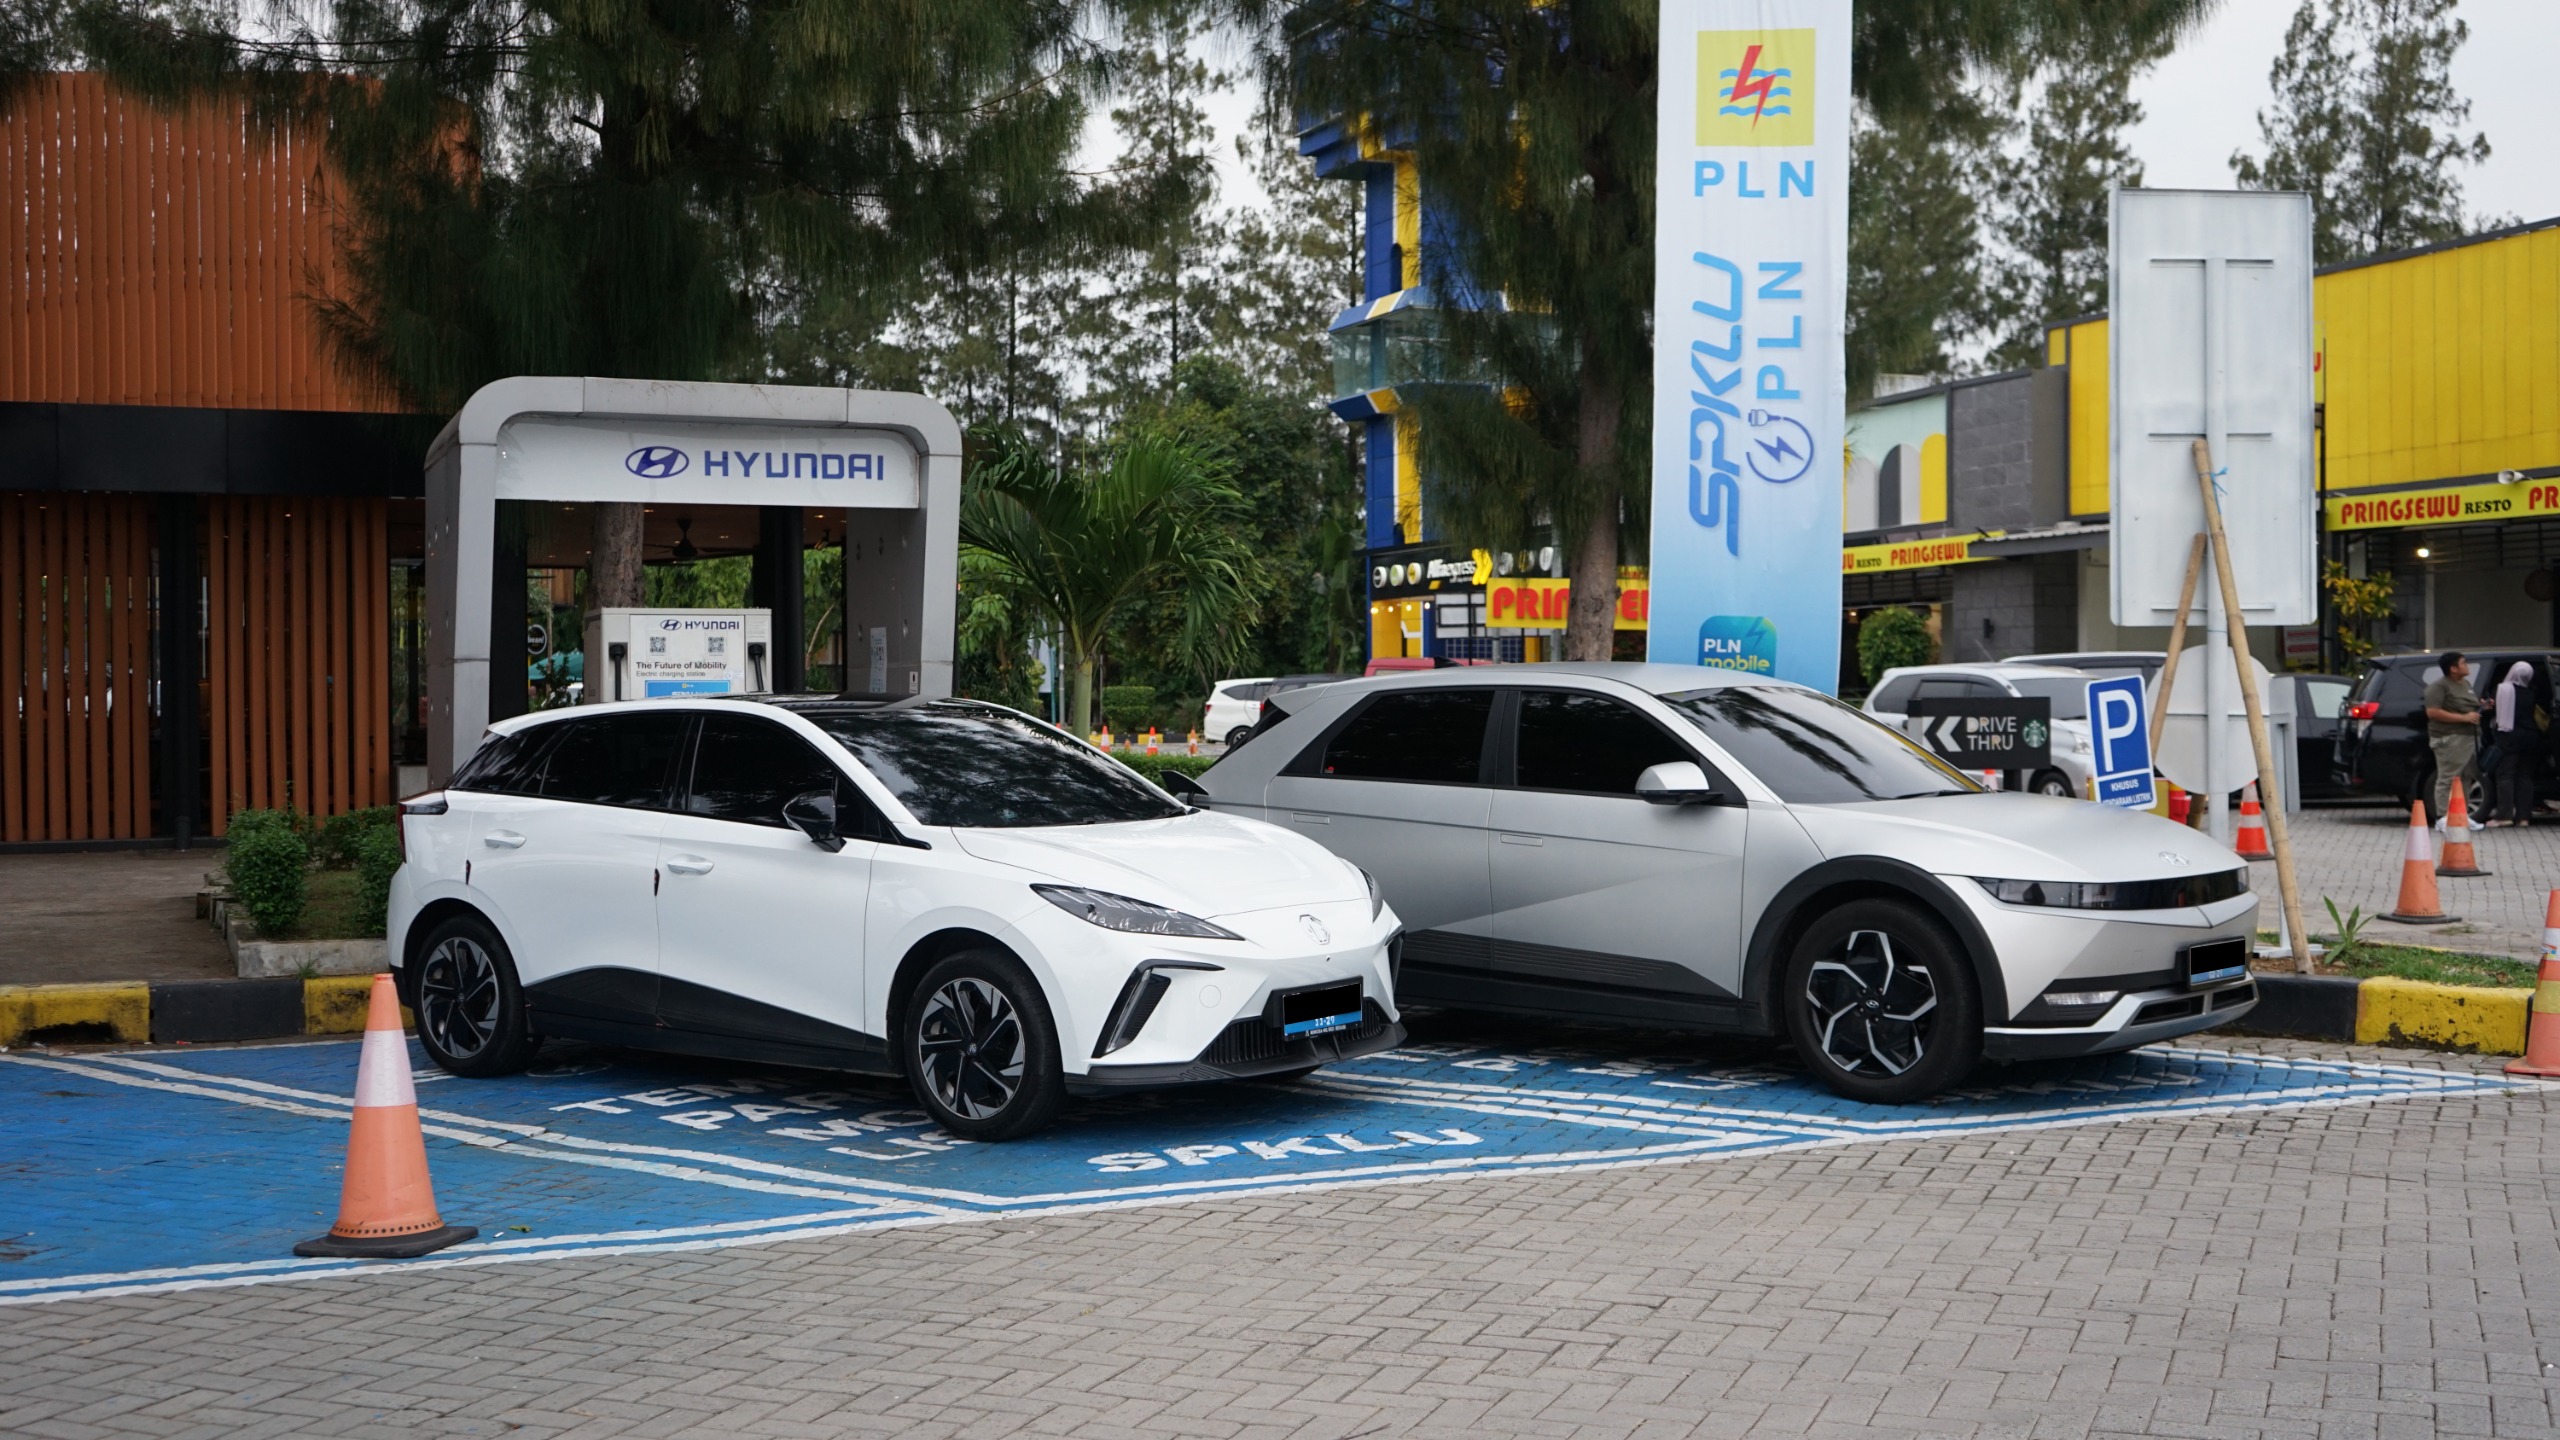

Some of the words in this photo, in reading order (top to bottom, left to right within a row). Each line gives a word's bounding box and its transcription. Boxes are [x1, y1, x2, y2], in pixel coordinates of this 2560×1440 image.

[1694, 160, 1815, 198] PLN
[1756, 261, 1802, 400] PLN
[1688, 251, 1743, 558] SPKLU
[704, 450, 884, 481] HYUNDAI
[2528, 485, 2560, 511] PR
[2341, 494, 2461, 525] PRINGSEWU
[2464, 499, 2512, 515] RESTO
[1856, 557, 1882, 568] RESTO
[1890, 541, 1965, 567] PRINGSEWU
[684, 620, 740, 631] HYUNDAI
[1704, 638, 1742, 653] PLN
[636, 661, 652, 670] The
[654, 661, 682, 670] Future
[684, 661, 693, 670] of
[694, 661, 727, 671] Mobility
[659, 670, 685, 678] charging
[1704, 655, 1771, 672] mobile
[1966, 716, 2018, 733] DRIVE
[2098, 689, 2138, 773] P
[1967, 734, 2014, 751] THRU
[2110, 778, 2139, 792] KHUSUS
[1087, 1128, 1484, 1173] SPKLU
